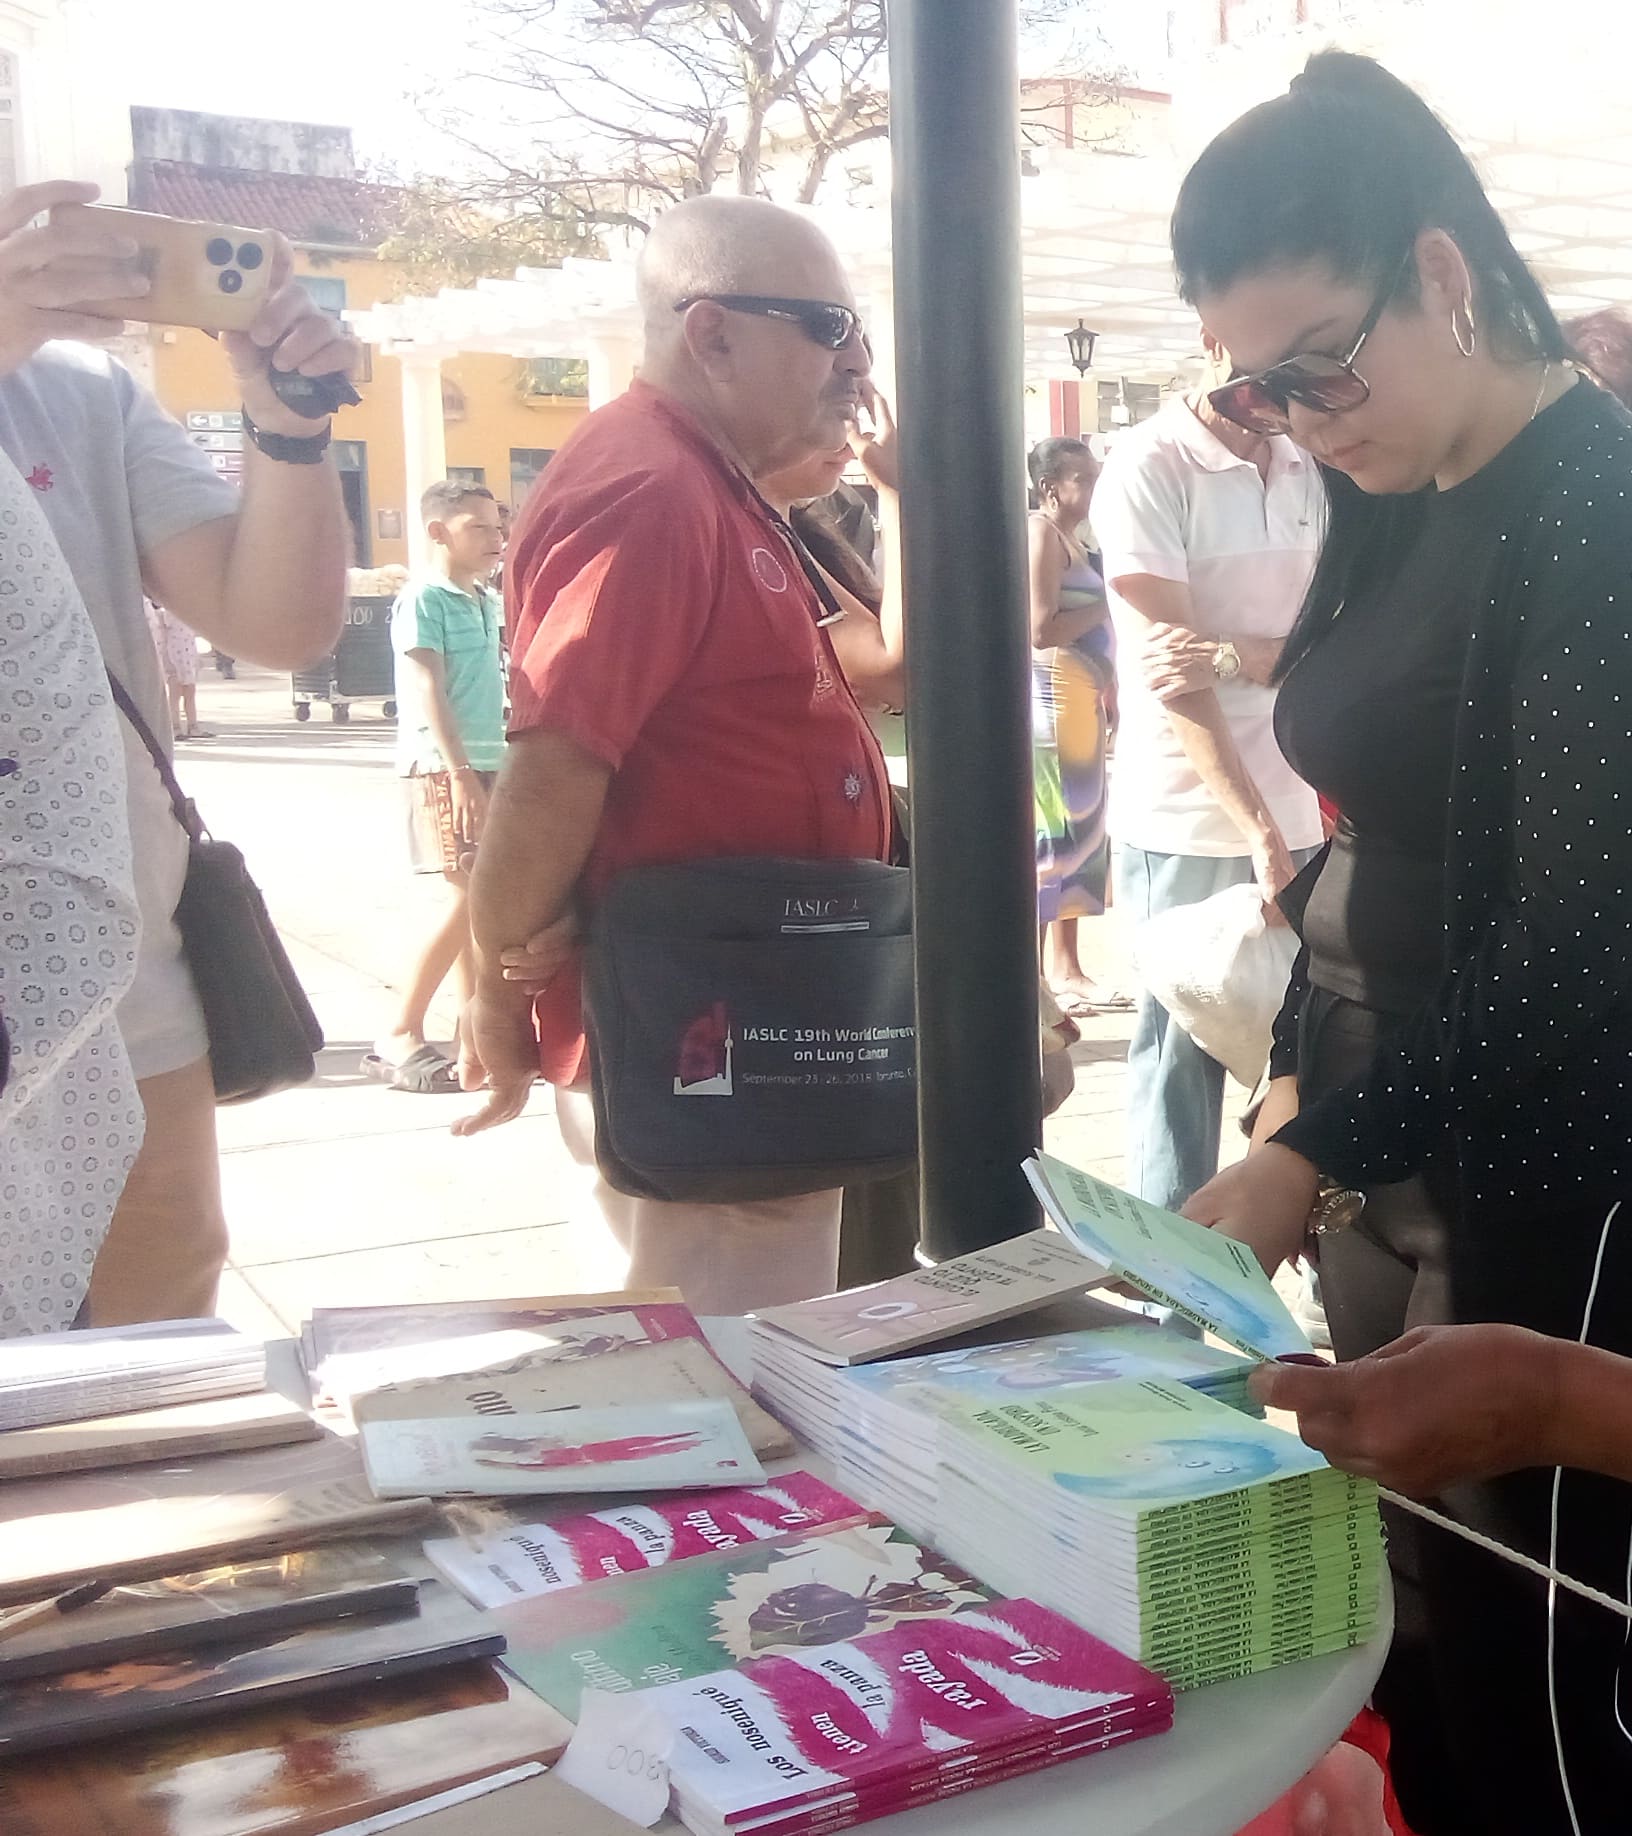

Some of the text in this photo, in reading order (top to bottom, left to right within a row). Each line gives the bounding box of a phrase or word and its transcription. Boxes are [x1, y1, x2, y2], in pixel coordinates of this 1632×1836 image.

[784, 898, 839, 916] IASLC
[743, 1028, 788, 1042] IASLC
[794, 1028, 831, 1042] 19th
[834, 1027, 872, 1042] World
[793, 1047, 889, 1064] on Lung Cancer
[742, 1073, 802, 1086] September
[616, 1515, 666, 1554] la panza
[820, 1659, 886, 1708] la panza
[898, 1650, 987, 1710] rayada
[692, 1685, 773, 1752] noseniqué
[810, 1711, 869, 1754] tienen
[767, 1755, 809, 1780] Los
